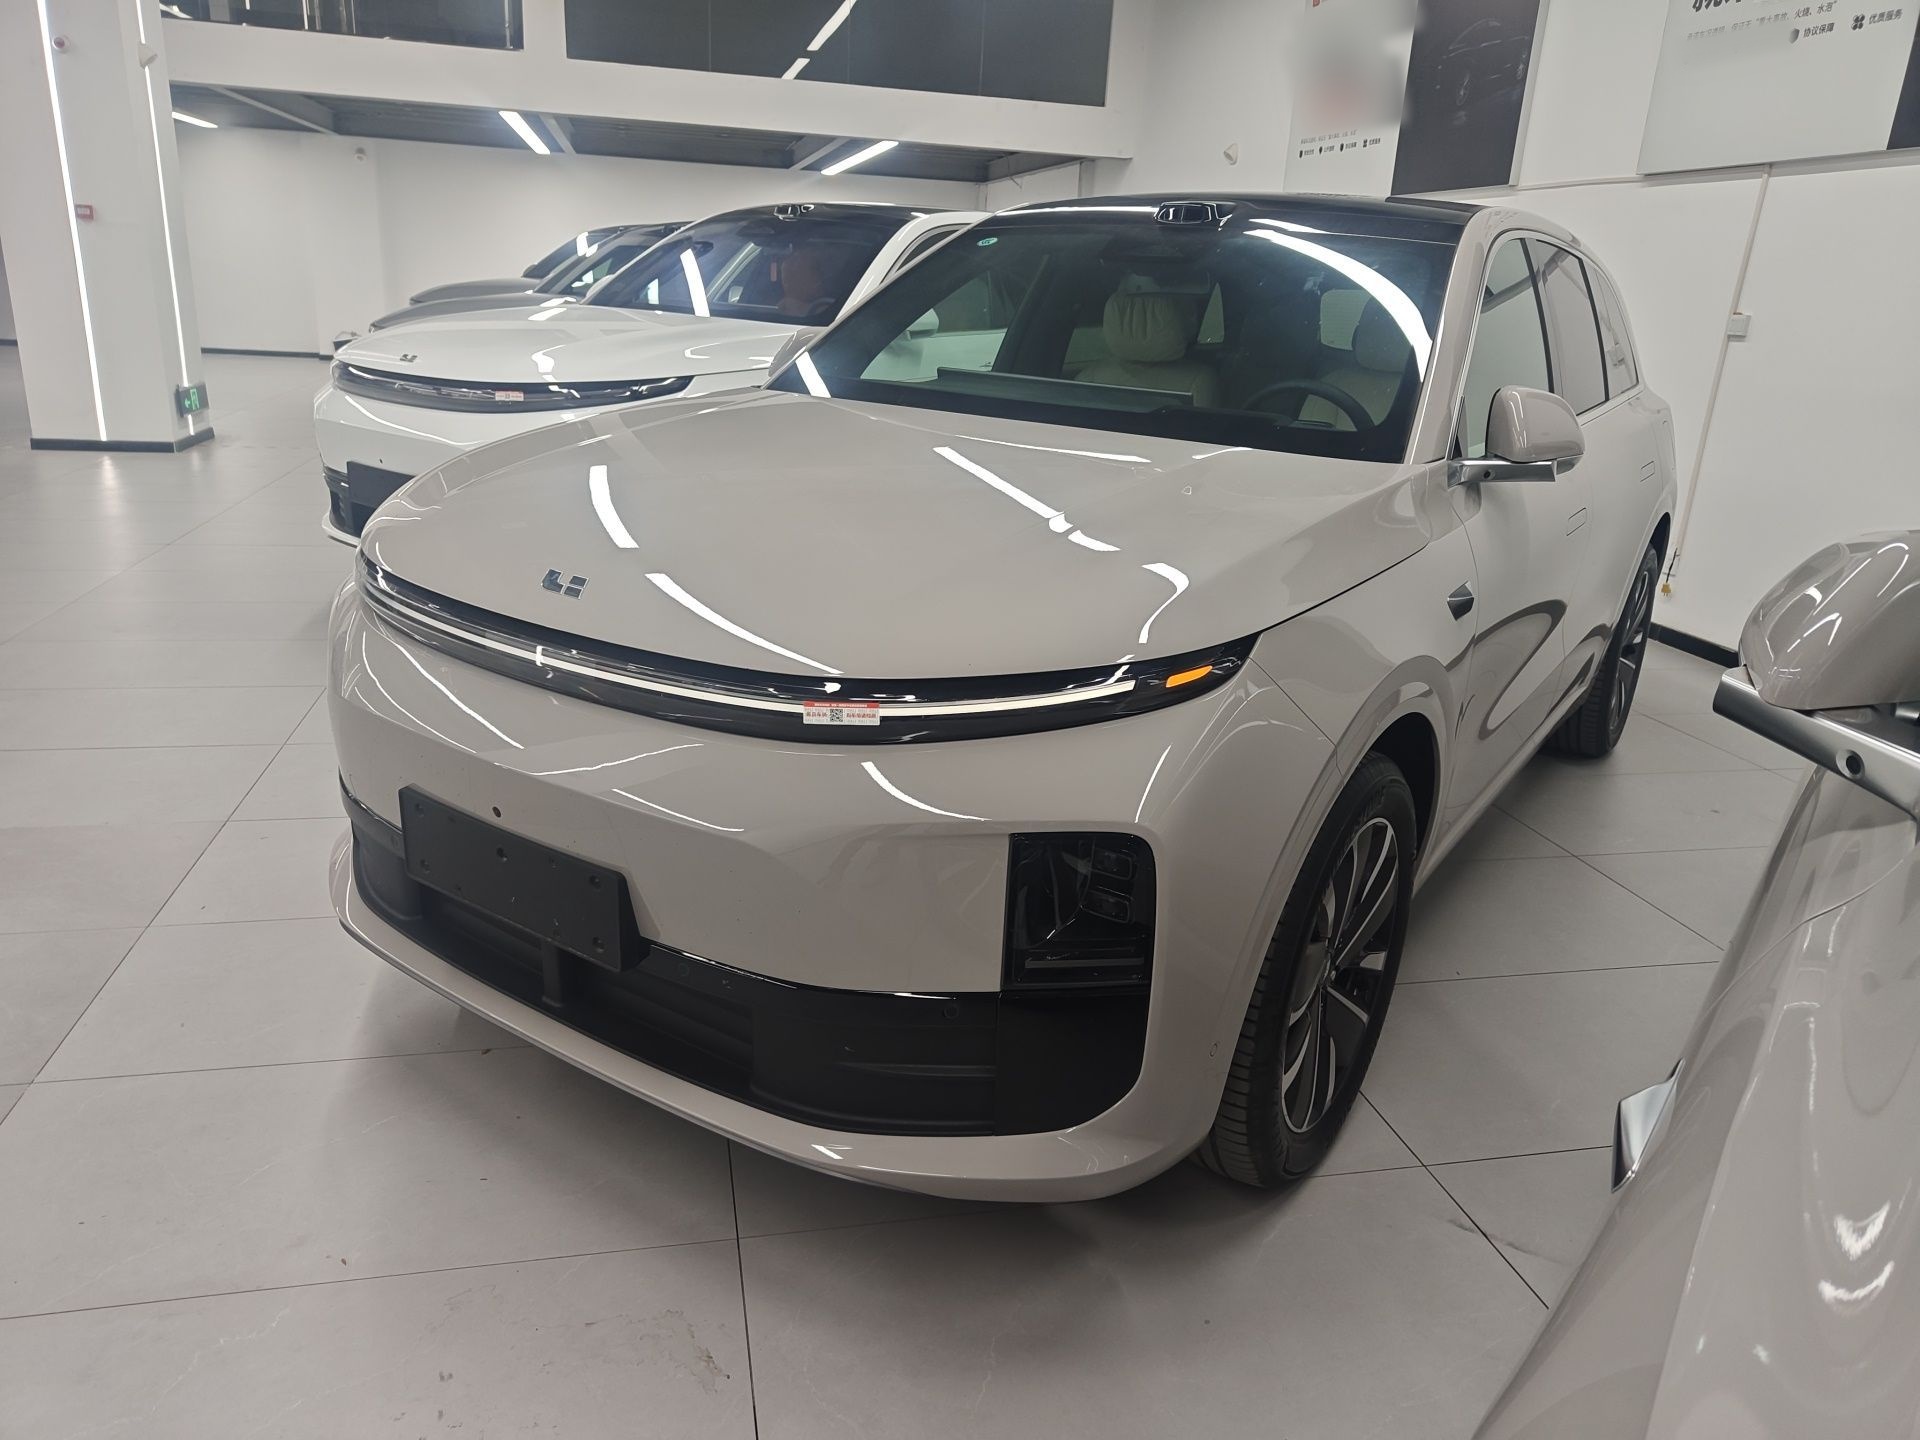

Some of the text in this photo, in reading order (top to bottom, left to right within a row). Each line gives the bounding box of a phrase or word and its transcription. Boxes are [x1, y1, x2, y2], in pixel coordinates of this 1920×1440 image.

[1868, 8, 1904, 25] 优质服务
[1803, 22, 1835, 38] 协议保障
